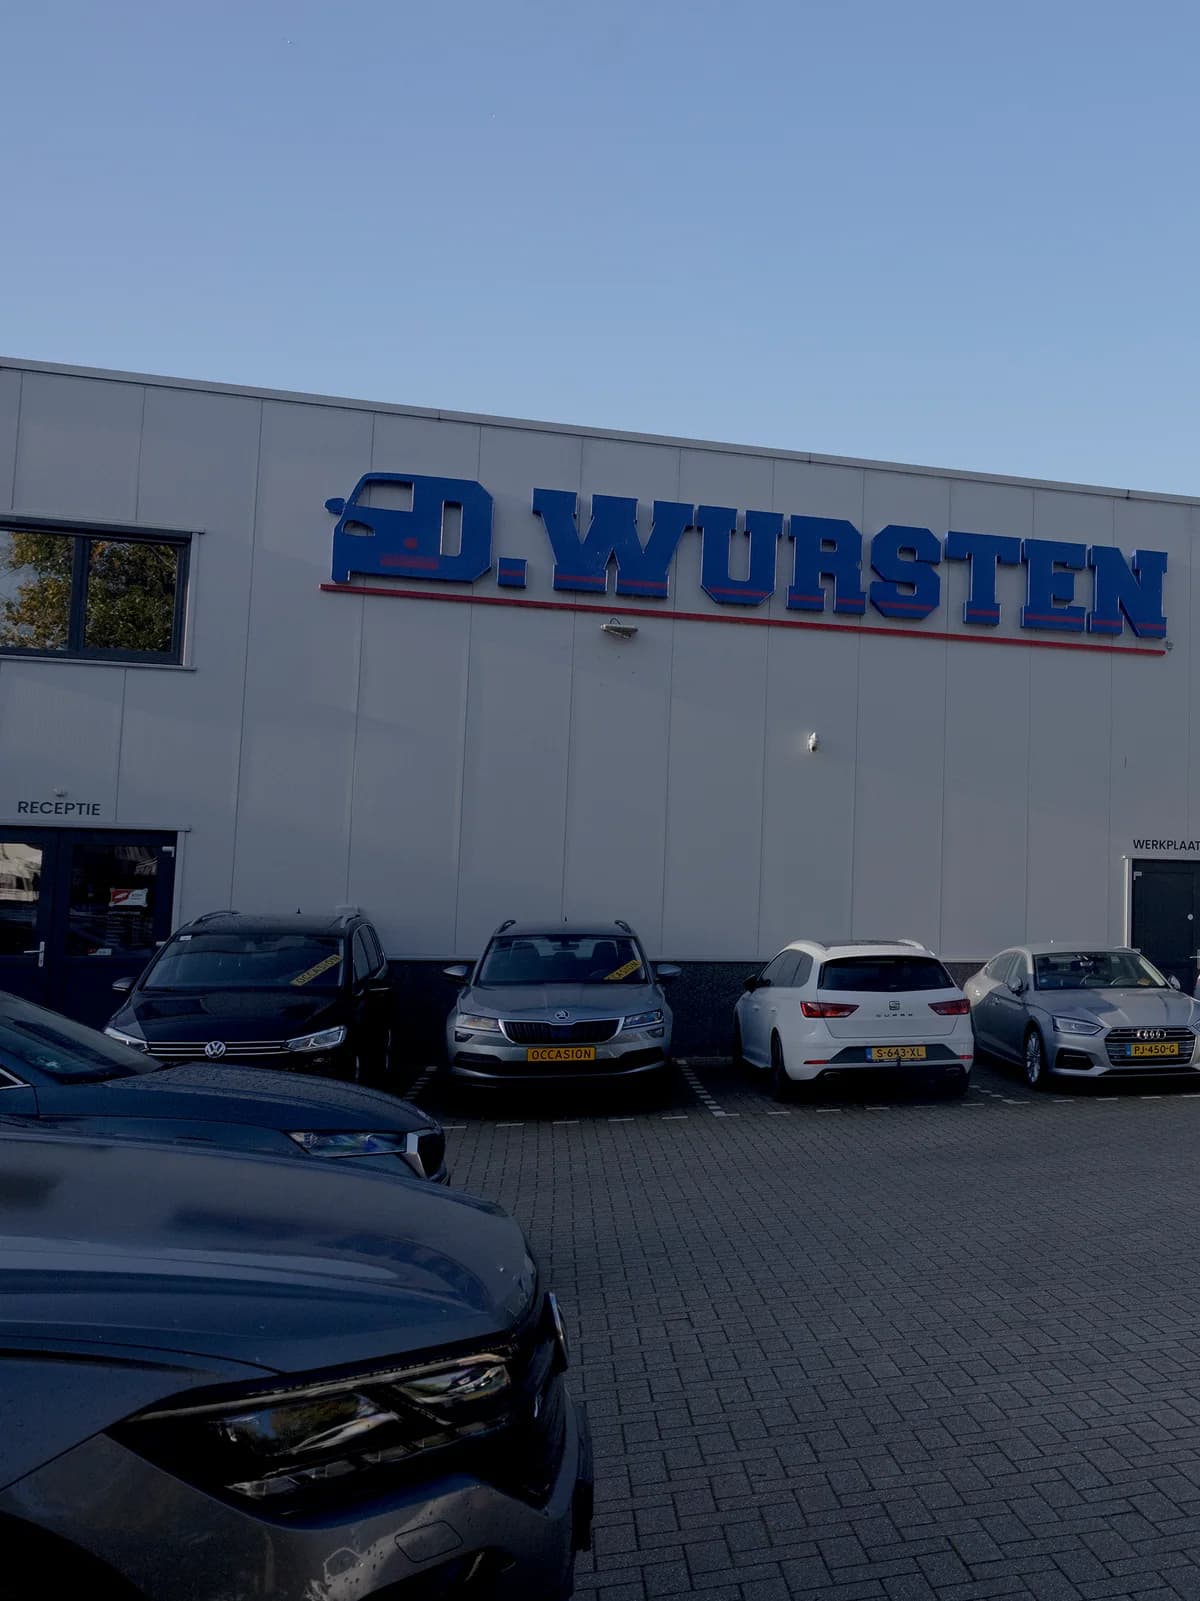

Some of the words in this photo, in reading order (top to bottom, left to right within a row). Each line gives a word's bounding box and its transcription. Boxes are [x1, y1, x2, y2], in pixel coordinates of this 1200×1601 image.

[17, 801, 101, 816] RECEPTIE
[532, 1049, 591, 1060] OCCASION
[876, 1048, 923, 1058] S-643-XL
[1134, 1044, 1175, 1055] PJ-450-G
